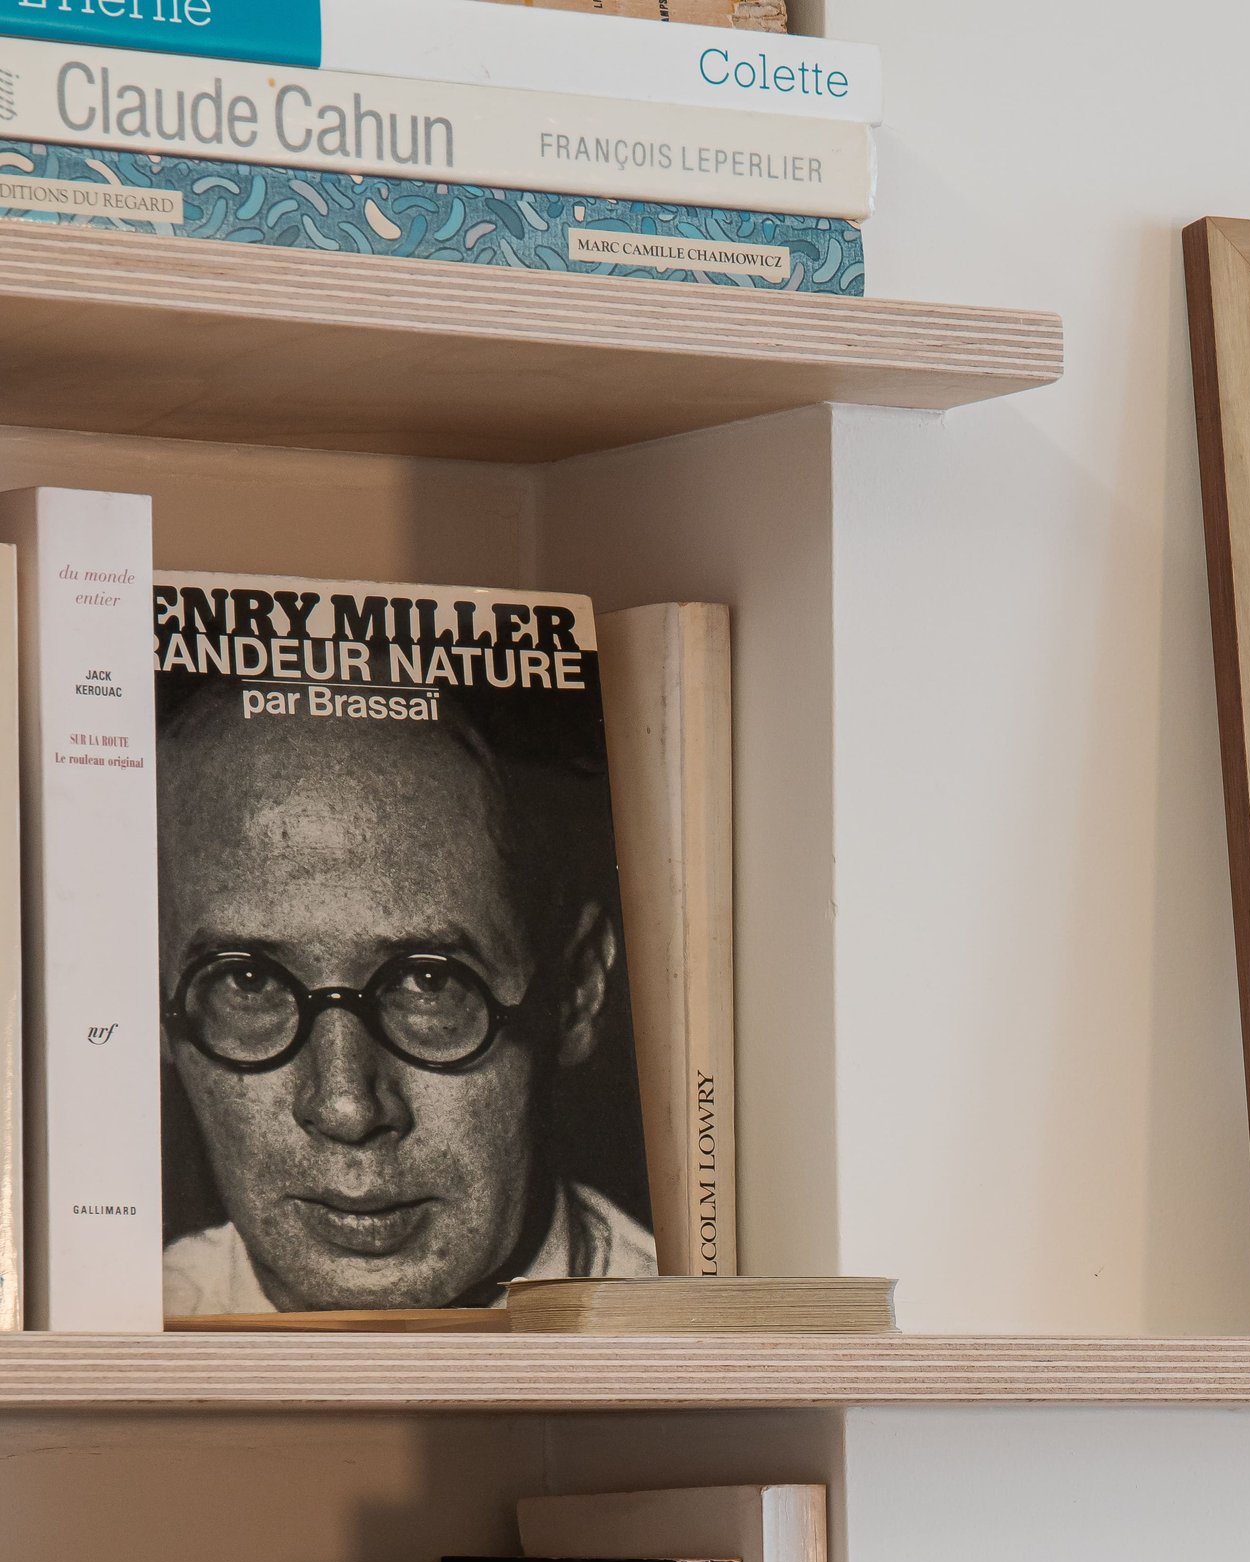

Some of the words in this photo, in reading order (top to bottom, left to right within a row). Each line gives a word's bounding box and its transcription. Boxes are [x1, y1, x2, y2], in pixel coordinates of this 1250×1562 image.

[699, 48, 849, 97] Colette
[57, 61, 258, 147] Claude
[275, 84, 454, 167] Cahun
[540, 132, 672, 170] FRANÇOIS
[682, 146, 822, 182] LEPERLIER
[0, 183, 68, 204] DITIONS
[73, 189, 99, 206] DU
[103, 192, 174, 213] REGARD
[578, 238, 619, 255] MARC
[622, 243, 685, 260] CAMILLE
[688, 248, 783, 268] CHAIMOWICZ
[59, 564, 79, 581] du
[84, 569, 136, 585] monde
[75, 591, 121, 608] entier
[153, 584, 321, 638] ENRY
[330, 594, 579, 650] MILLER
[85, 670, 112, 682] JACK
[390, 643, 586, 690] NATURE
[75, 684, 123, 698] KEROUAC
[241, 688, 300, 720] par
[309, 687, 439, 721] Brassaï
[70, 733, 88, 745] SUR
[89, 734, 100, 746] LA
[102, 735, 129, 748] ROUTE
[55, 753, 67, 764] Le
[69, 754, 105, 766] rouleau
[108, 757, 144, 770] original
[87, 1023, 119, 1045] nrf
[697, 1069, 716, 1171] LOWRY
[73, 1205, 137, 1216] GALLIMARD
[699, 1180, 718, 1276] LCOLM
